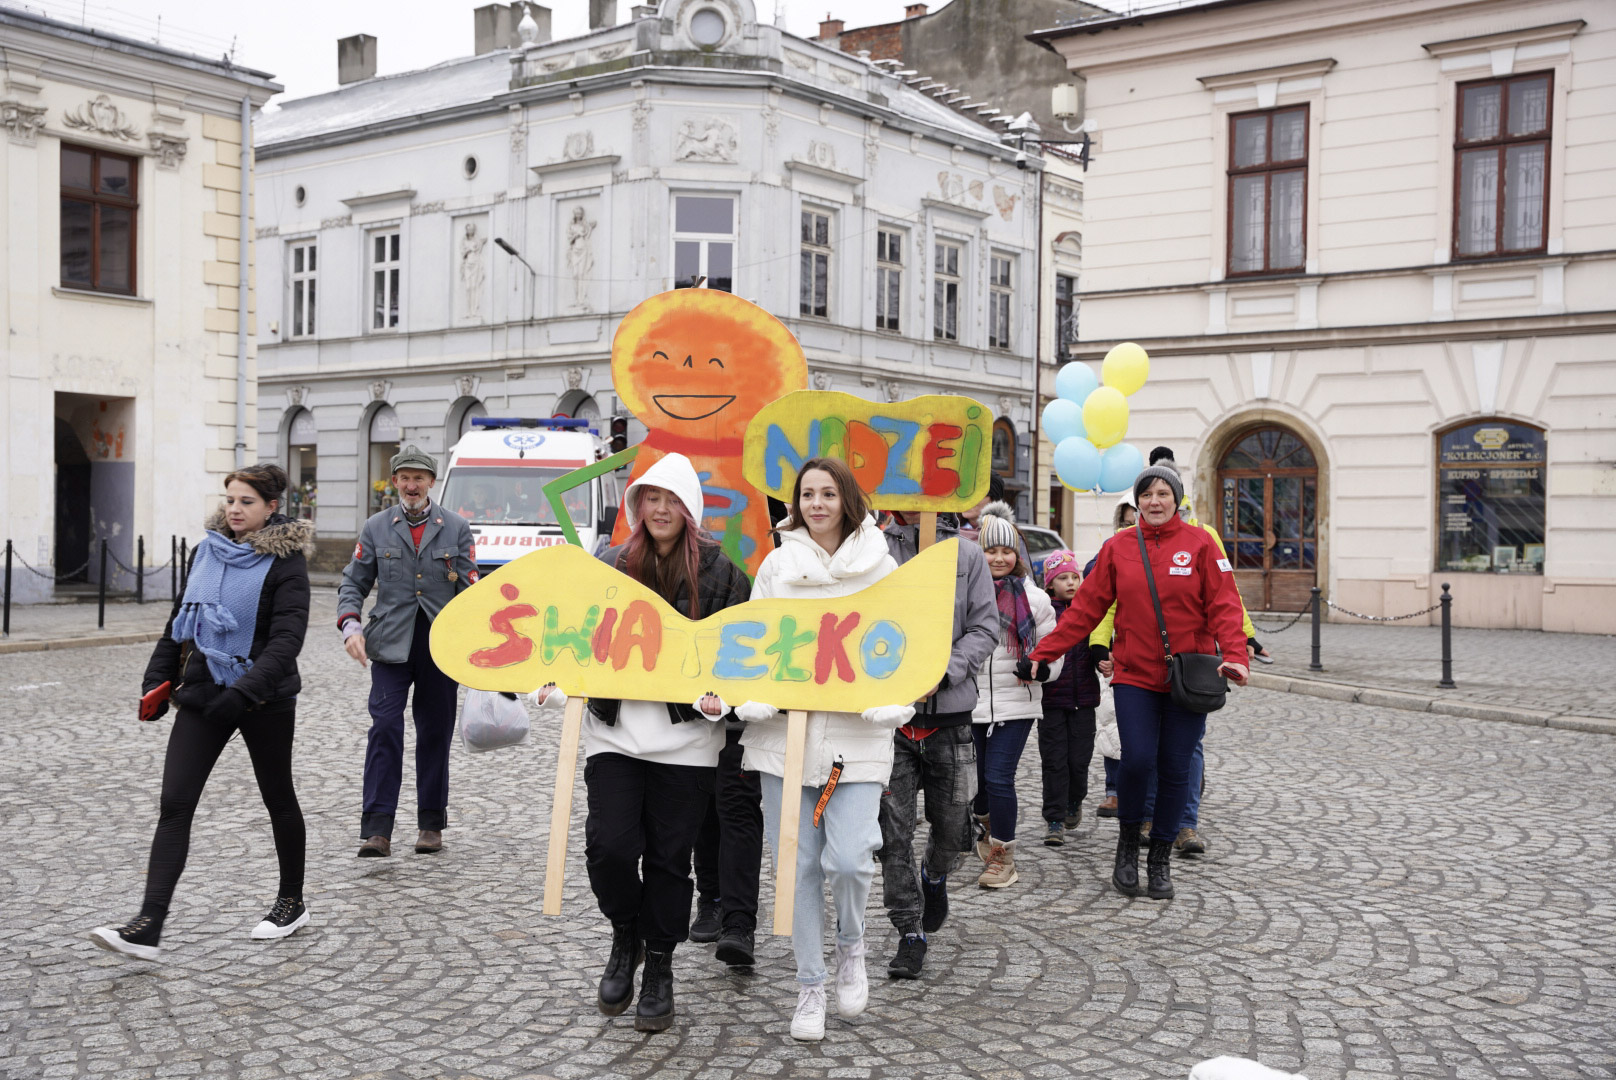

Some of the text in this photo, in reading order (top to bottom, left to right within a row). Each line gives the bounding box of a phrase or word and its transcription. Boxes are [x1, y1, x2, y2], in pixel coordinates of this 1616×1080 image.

[1447, 470, 1480, 479] KUPNO
[1490, 468, 1538, 479] SPRZEDAŻ
[1225, 482, 1234, 534] ANTYKI
[825, 782, 835, 797] SINCE
